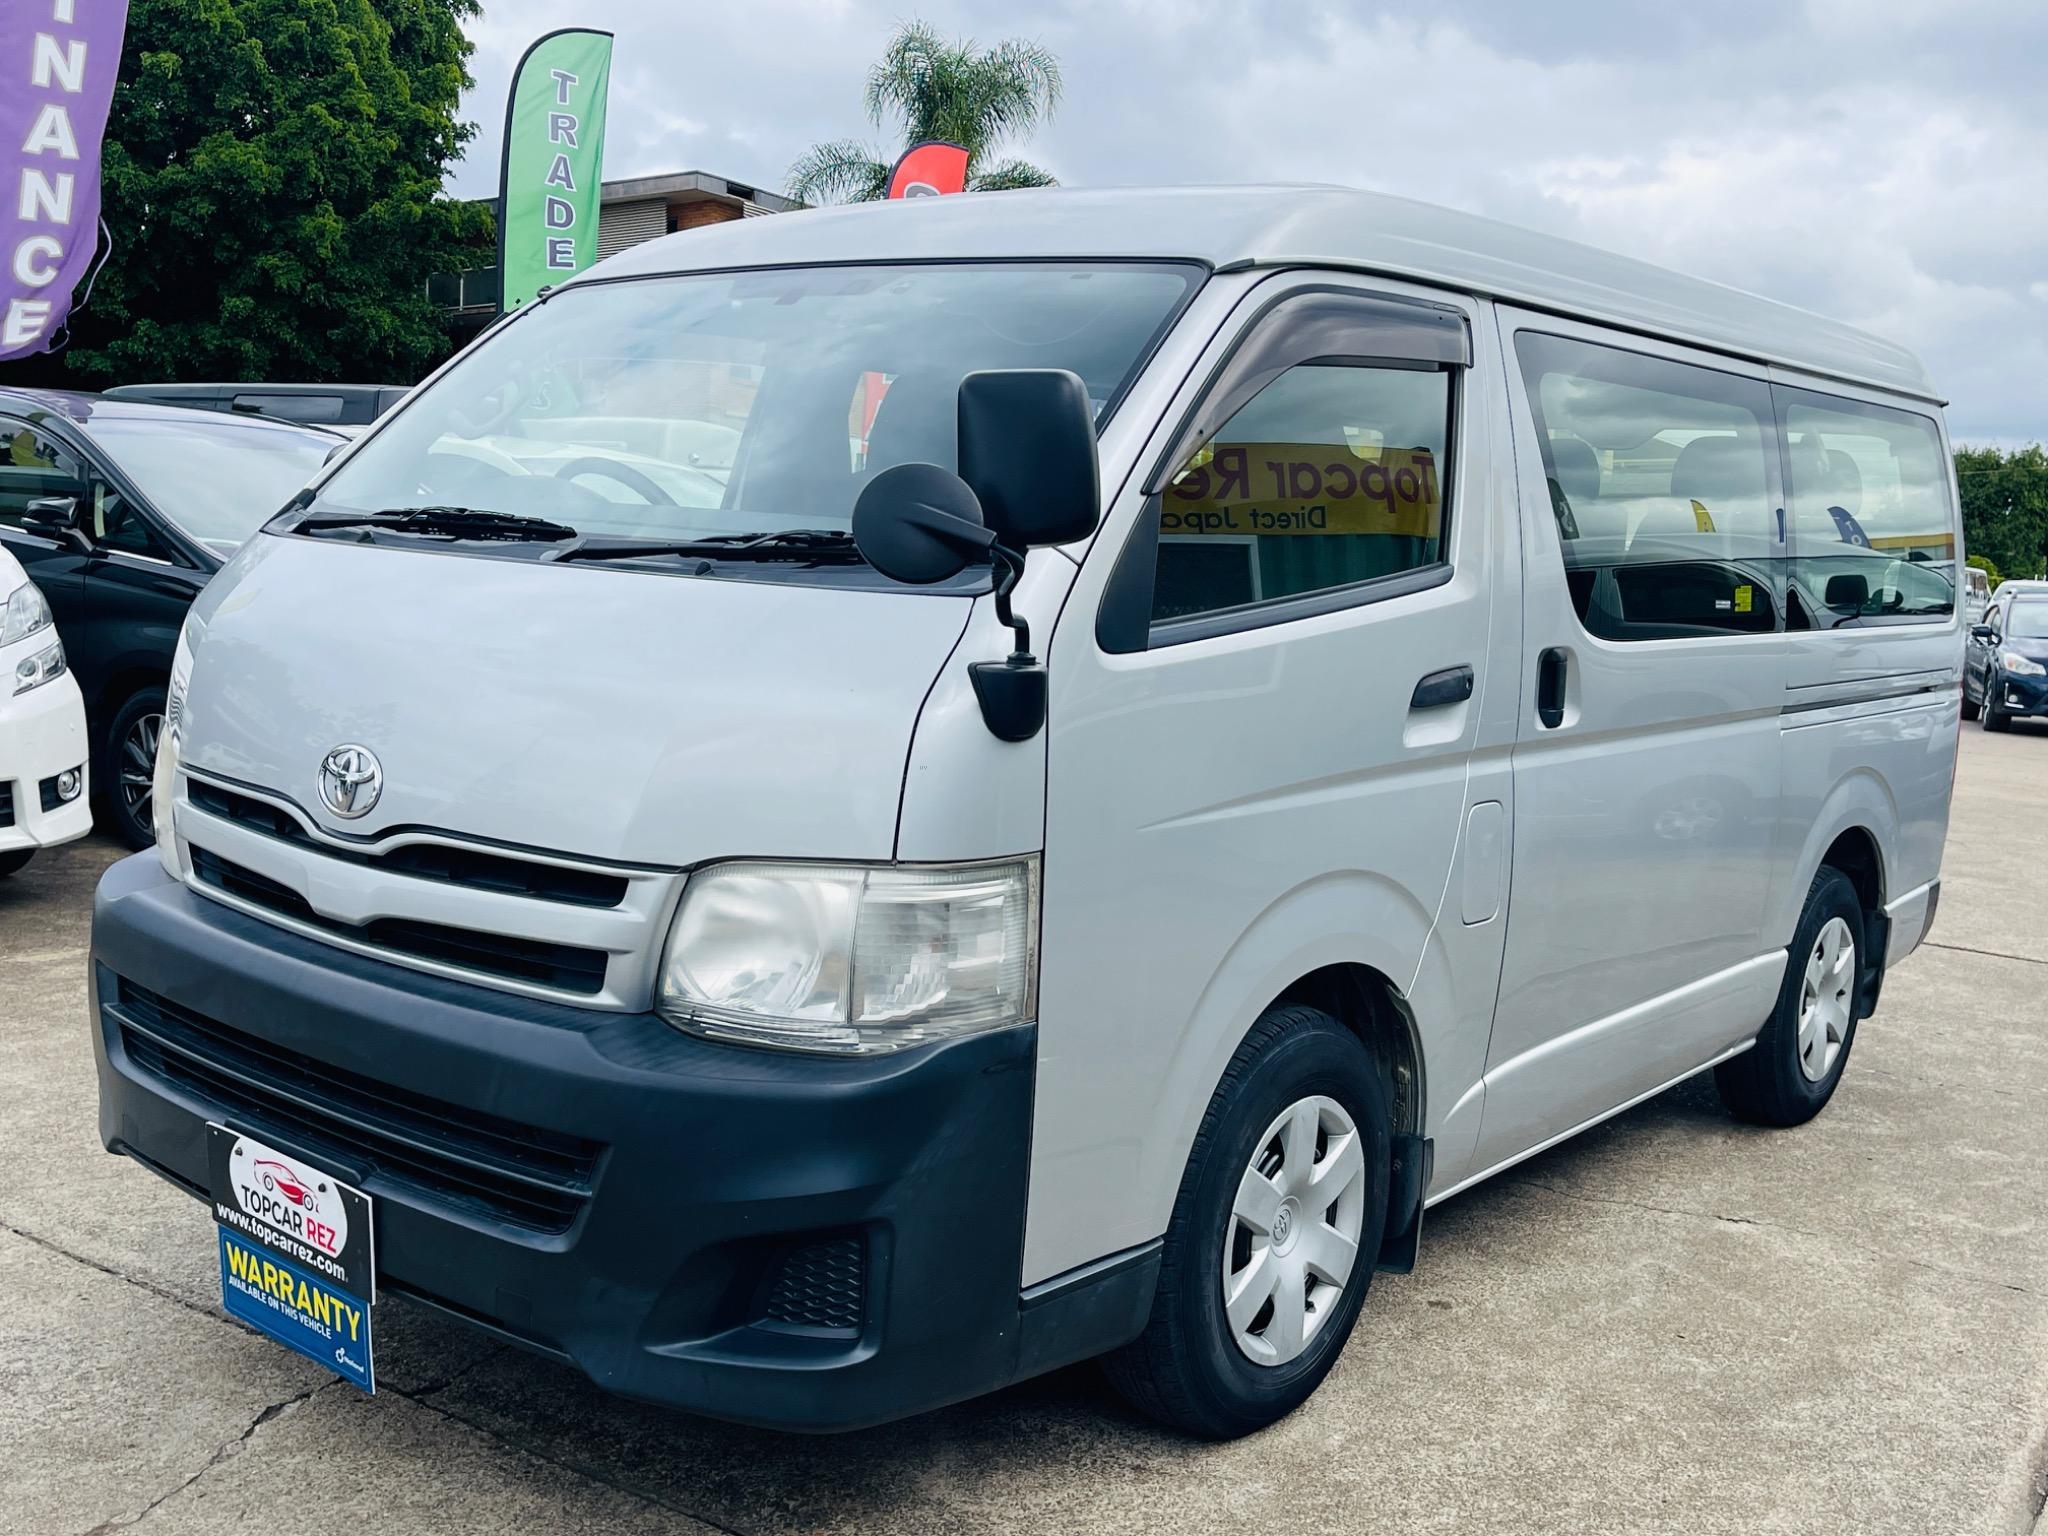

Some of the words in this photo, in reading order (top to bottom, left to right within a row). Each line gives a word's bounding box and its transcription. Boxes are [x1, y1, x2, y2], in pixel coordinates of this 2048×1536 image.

[544, 68, 579, 270] TRADE
[241, 1184, 303, 1236] TOPCAR
[306, 1216, 337, 1254] REZ
[225, 1241, 361, 1342] WARRANTY
[228, 1274, 267, 1305] AVAILABLE
[267, 1296, 279, 1311] ON
[279, 1302, 299, 1321] THIS
[298, 1311, 332, 1341] VEHICLE
